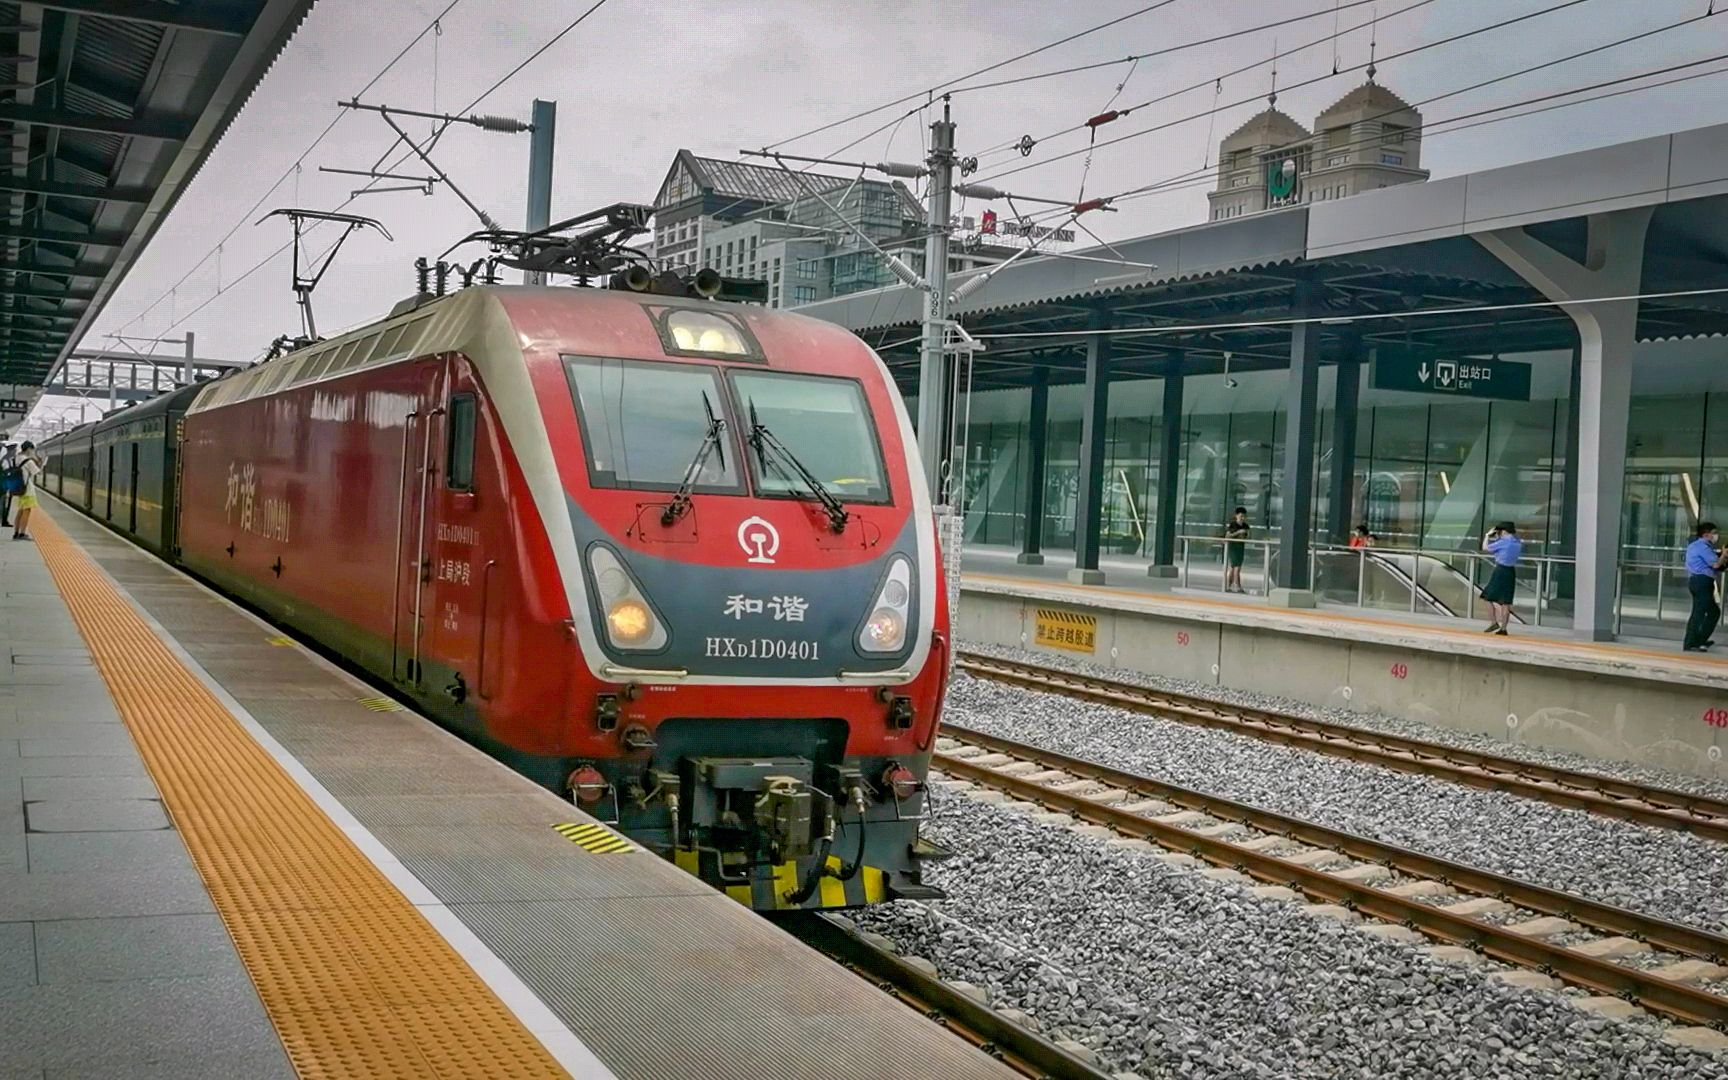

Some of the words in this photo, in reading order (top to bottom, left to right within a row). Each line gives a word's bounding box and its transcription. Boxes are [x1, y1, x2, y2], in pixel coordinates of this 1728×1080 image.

[931, 291, 939, 317] 096
[1459, 365, 1491, 380] 出站口
[1459, 380, 1472, 390] Exit
[225, 461, 255, 533] 和谐
[438, 558, 471, 586] 上局沪段
[723, 594, 809, 622] 和谐
[1037, 624, 1094, 648] 禁止跨越股道
[1177, 631, 1190, 646] 50
[705, 637, 819, 660] HXD1D0401
[1391, 663, 1407, 679] 49
[1703, 708, 1728, 728] 48
